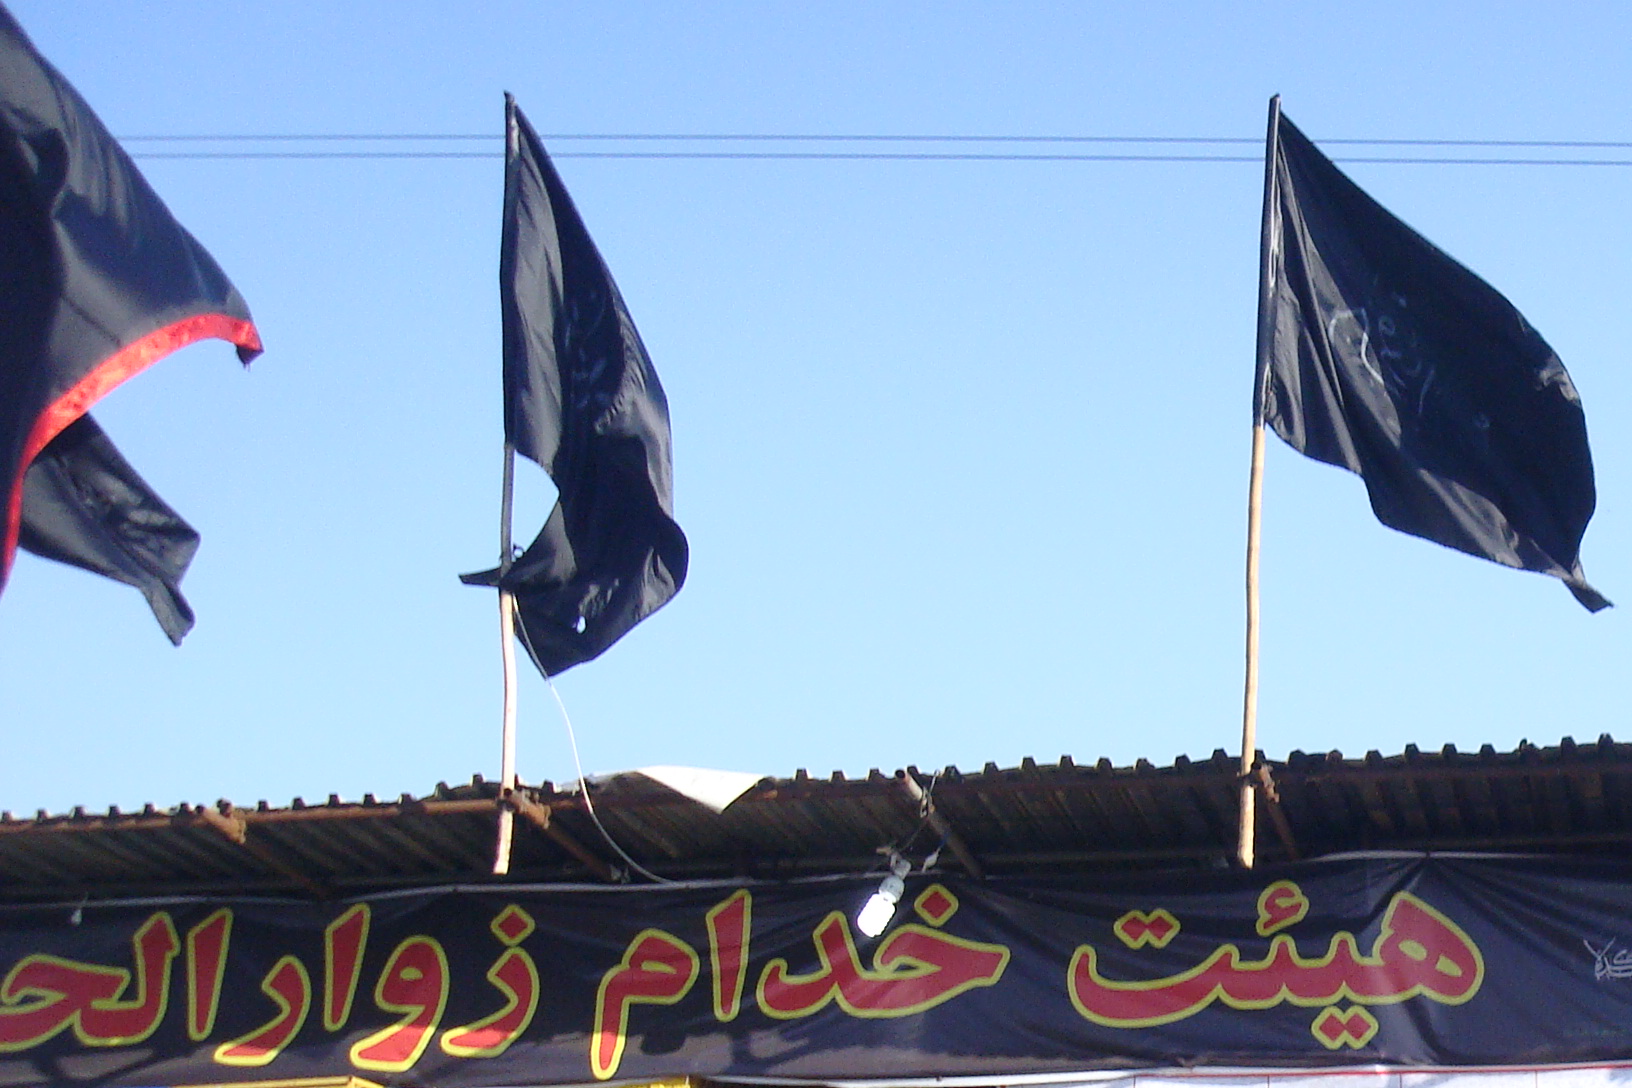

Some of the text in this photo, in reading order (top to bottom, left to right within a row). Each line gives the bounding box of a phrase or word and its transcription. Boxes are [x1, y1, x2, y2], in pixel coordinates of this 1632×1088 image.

[213, 902, 541, 1072] زوار
[590, 884, 1011, 1080] خدام
[1067, 880, 1485, 1050] هیئت
